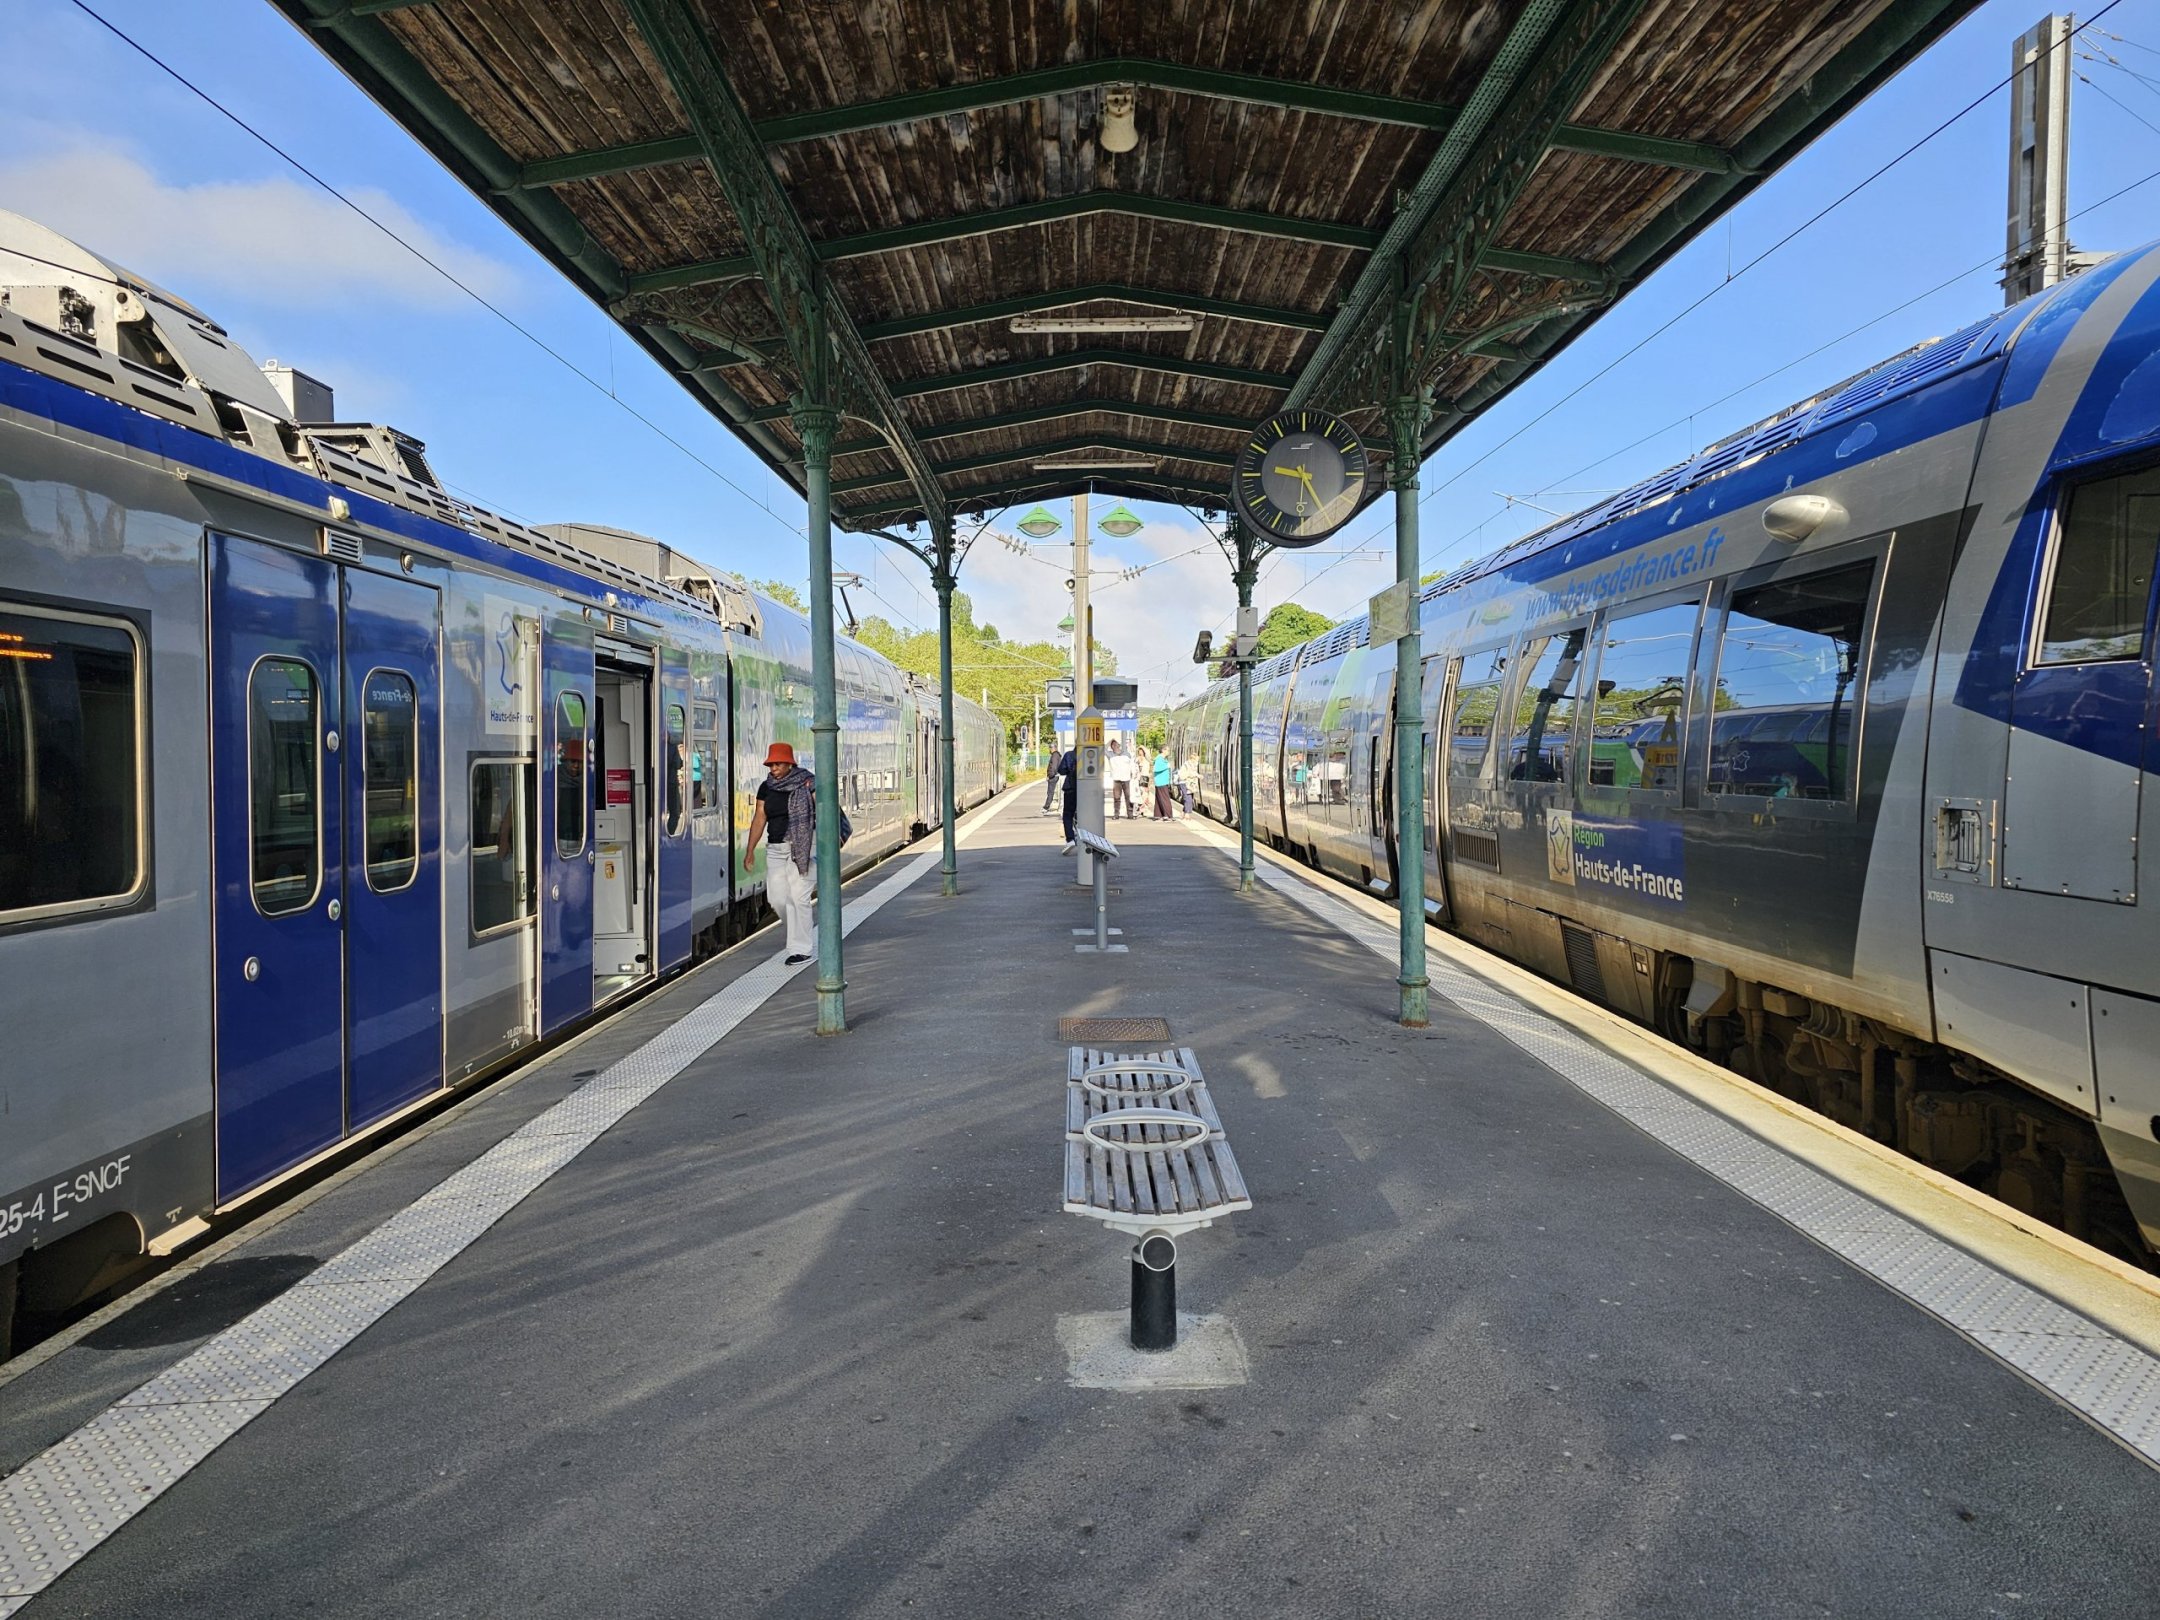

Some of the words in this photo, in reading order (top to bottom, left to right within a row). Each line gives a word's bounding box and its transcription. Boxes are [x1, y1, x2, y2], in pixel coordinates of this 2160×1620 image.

[490, 710, 534, 723] Hauts-de-Fce
[1574, 825, 1605, 849] Région
[1575, 852, 1683, 901] Hauts-de-France
